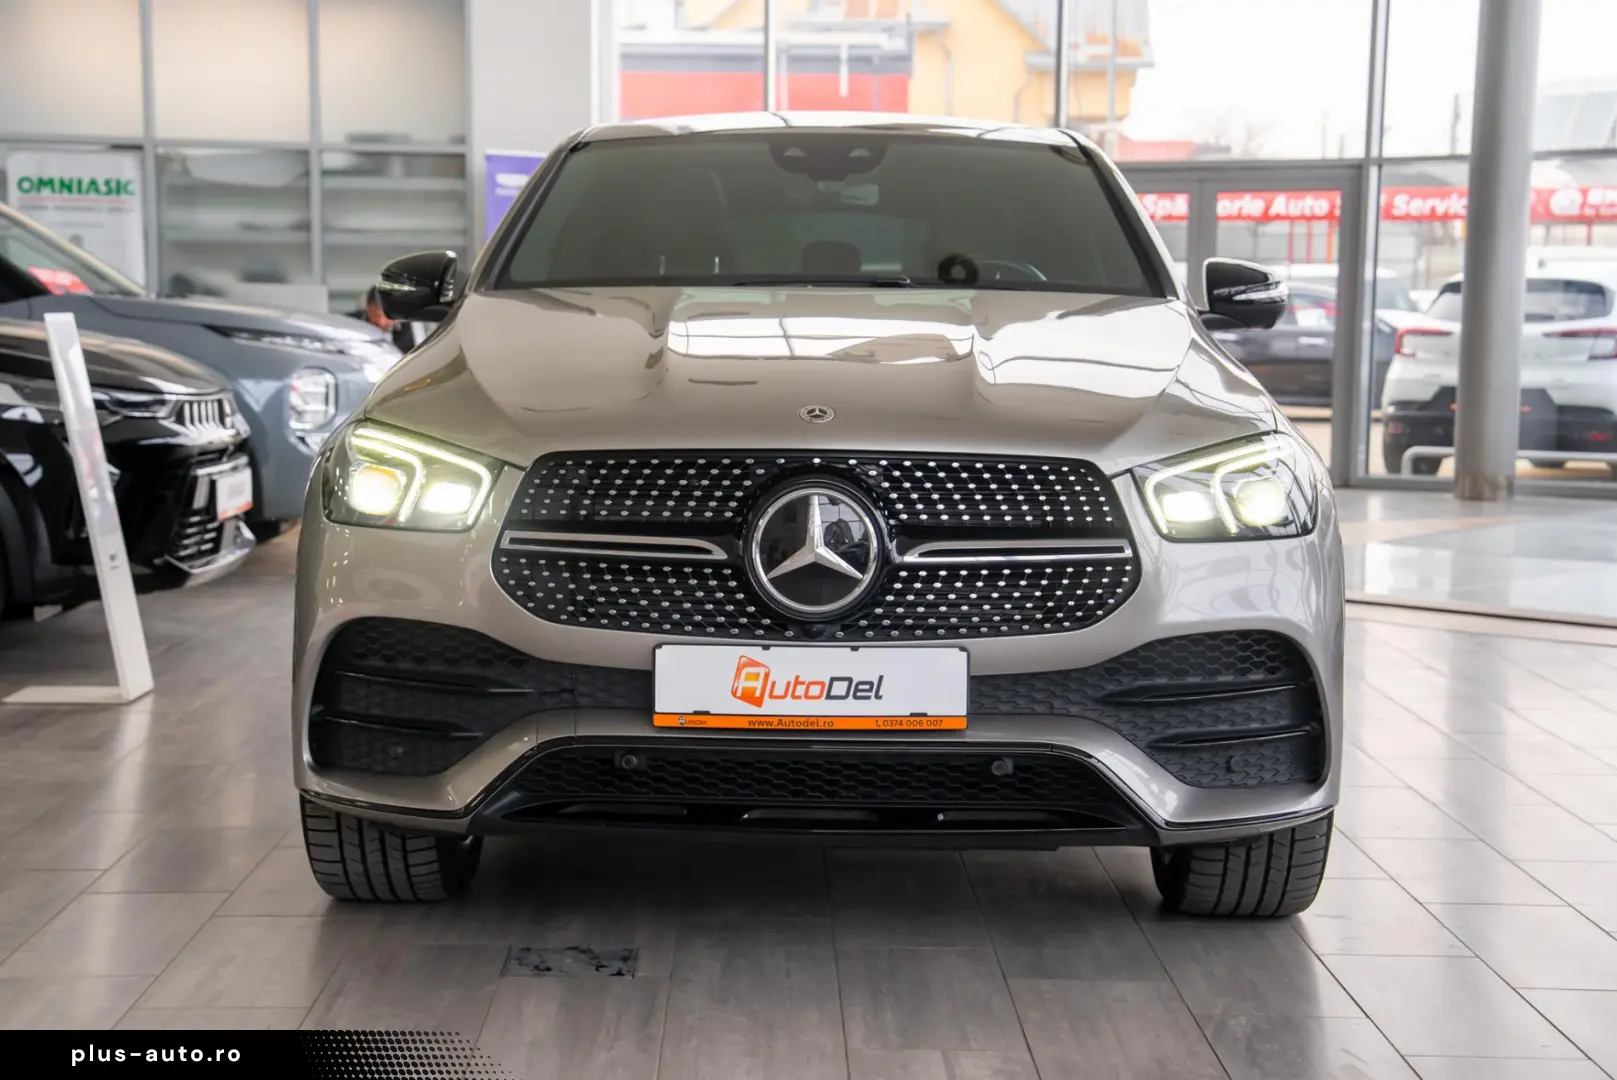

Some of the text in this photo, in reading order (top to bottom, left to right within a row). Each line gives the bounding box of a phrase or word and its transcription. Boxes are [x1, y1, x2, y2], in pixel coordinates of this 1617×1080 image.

[1268, 195, 1330, 217] Auto
[731, 655, 884, 708] AutoDel
[748, 718, 835, 728] www.Autodel.ro
[883, 719, 943, 728] 0374 006 007
